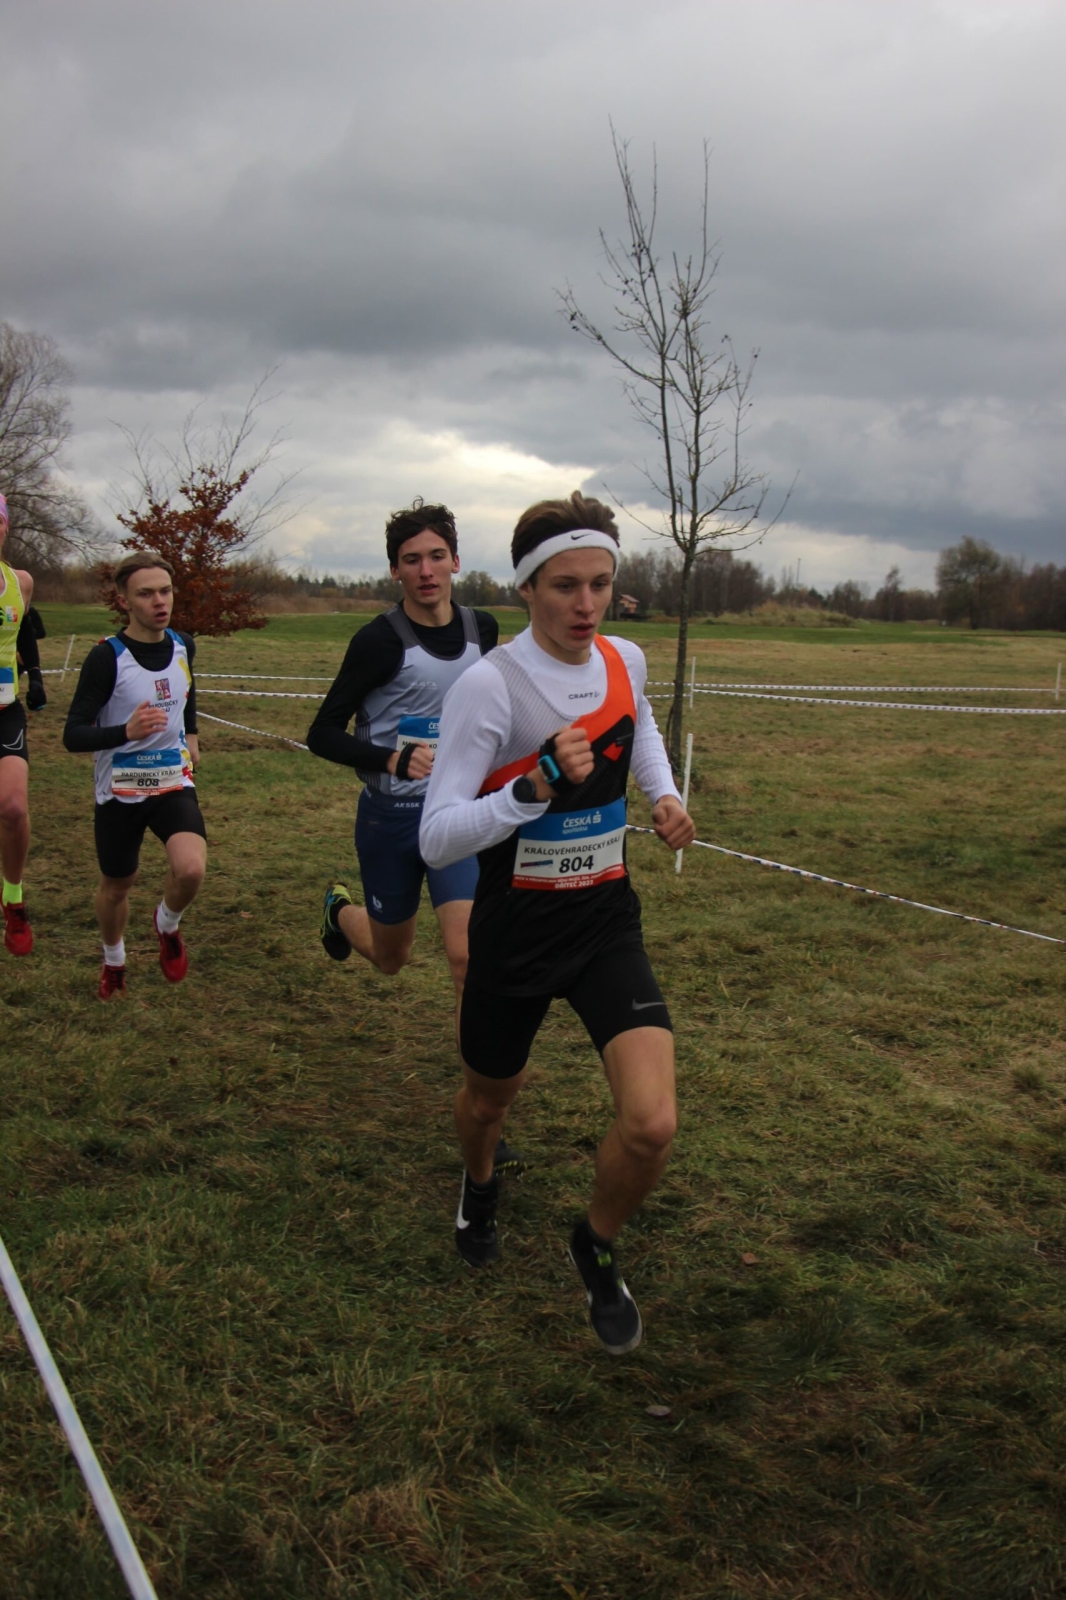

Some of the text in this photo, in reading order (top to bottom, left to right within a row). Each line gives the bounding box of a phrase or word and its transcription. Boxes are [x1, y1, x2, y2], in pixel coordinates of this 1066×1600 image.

[137, 778, 160, 787] 808
[562, 814, 591, 828] ČESKÁ
[524, 836, 621, 855] KRÁLOVÉHRADECKÝ KRAJ
[559, 855, 594, 874] 804
